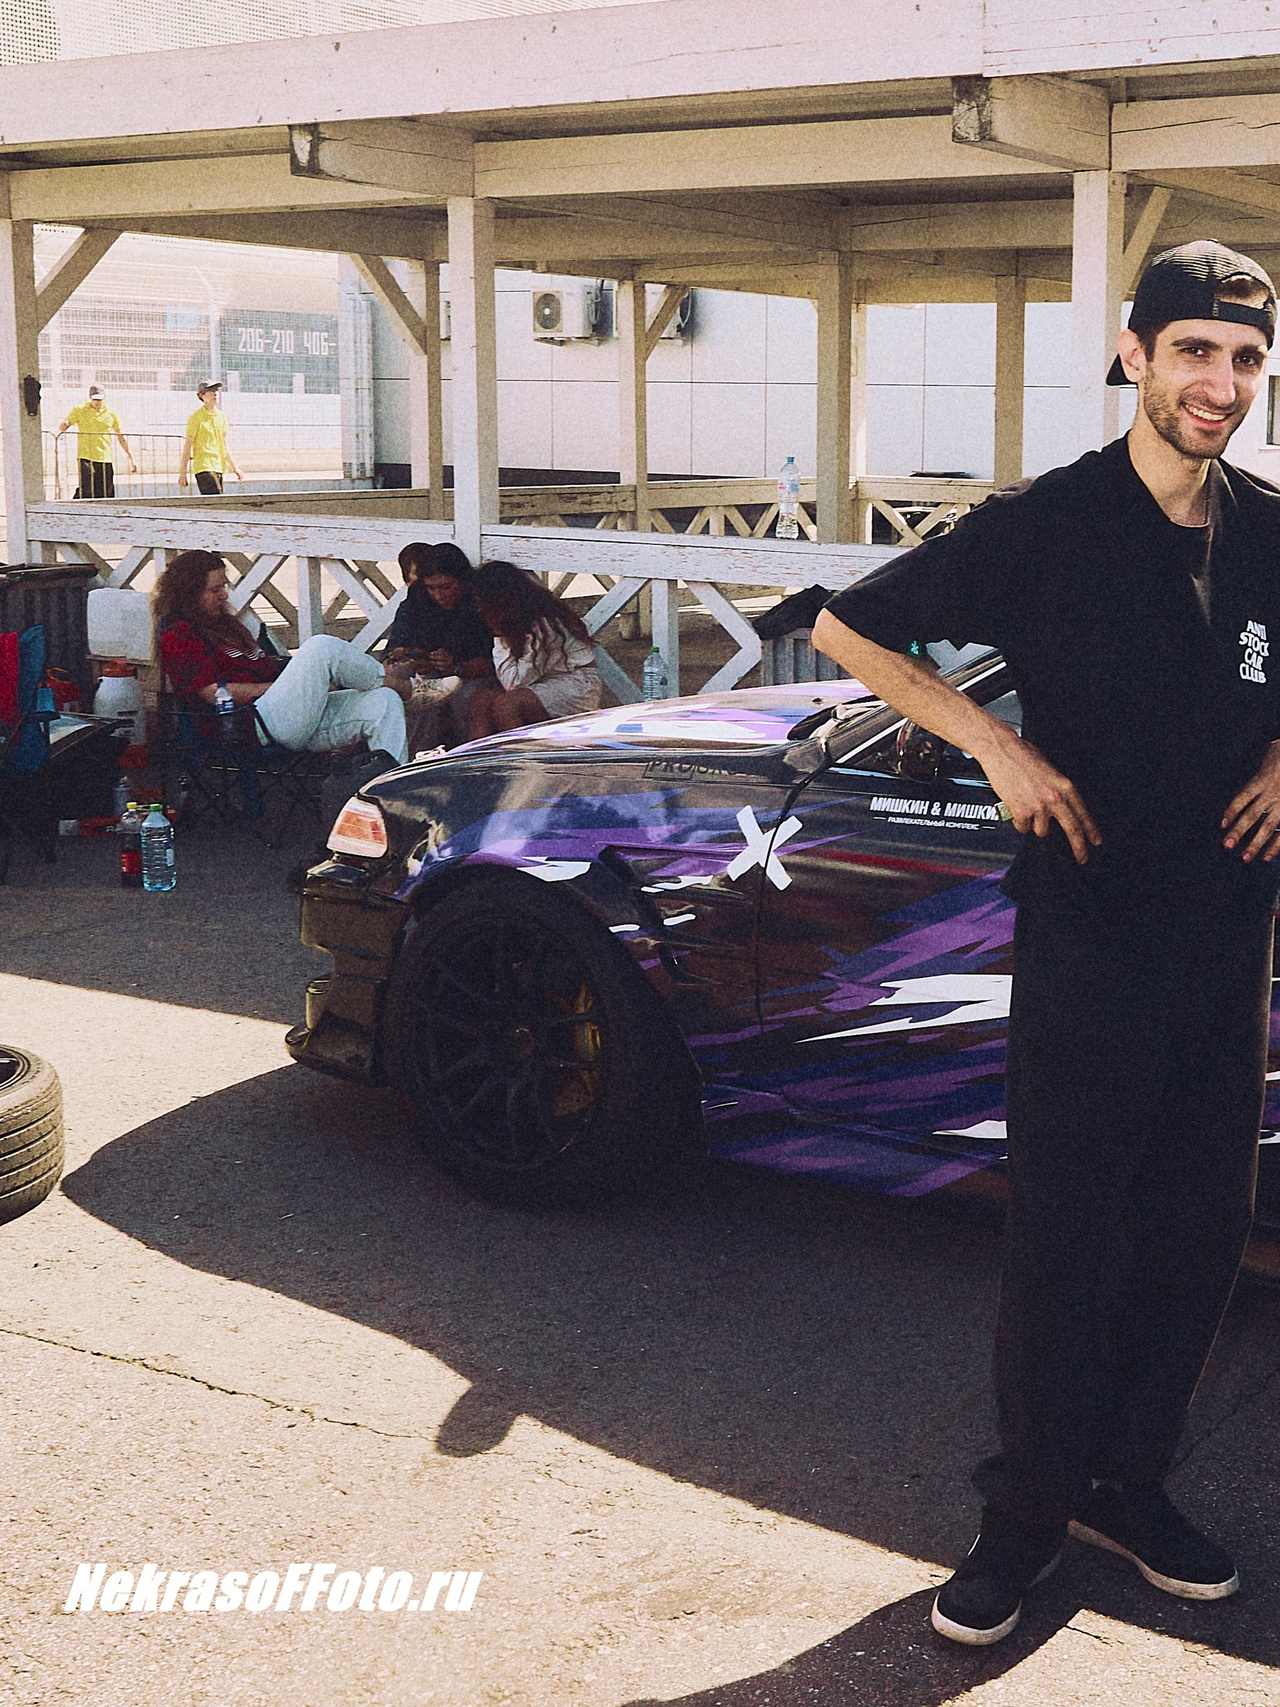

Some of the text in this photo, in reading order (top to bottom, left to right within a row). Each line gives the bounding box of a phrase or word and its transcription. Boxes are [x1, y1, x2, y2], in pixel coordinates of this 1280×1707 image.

[238, 327, 337, 356] 206-210 406-
[1246, 620, 1267, 641] ANTI
[1238, 631, 1270, 657] STOCK
[1244, 647, 1264, 671] CAR
[1239, 662, 1267, 684] CLUB
[869, 796, 999, 821] МИШКИН & МИШКИ
[887, 816, 980, 831] РАЗВЛЕКАТЕЛЬНЫЙ КОМПЛЕКС
